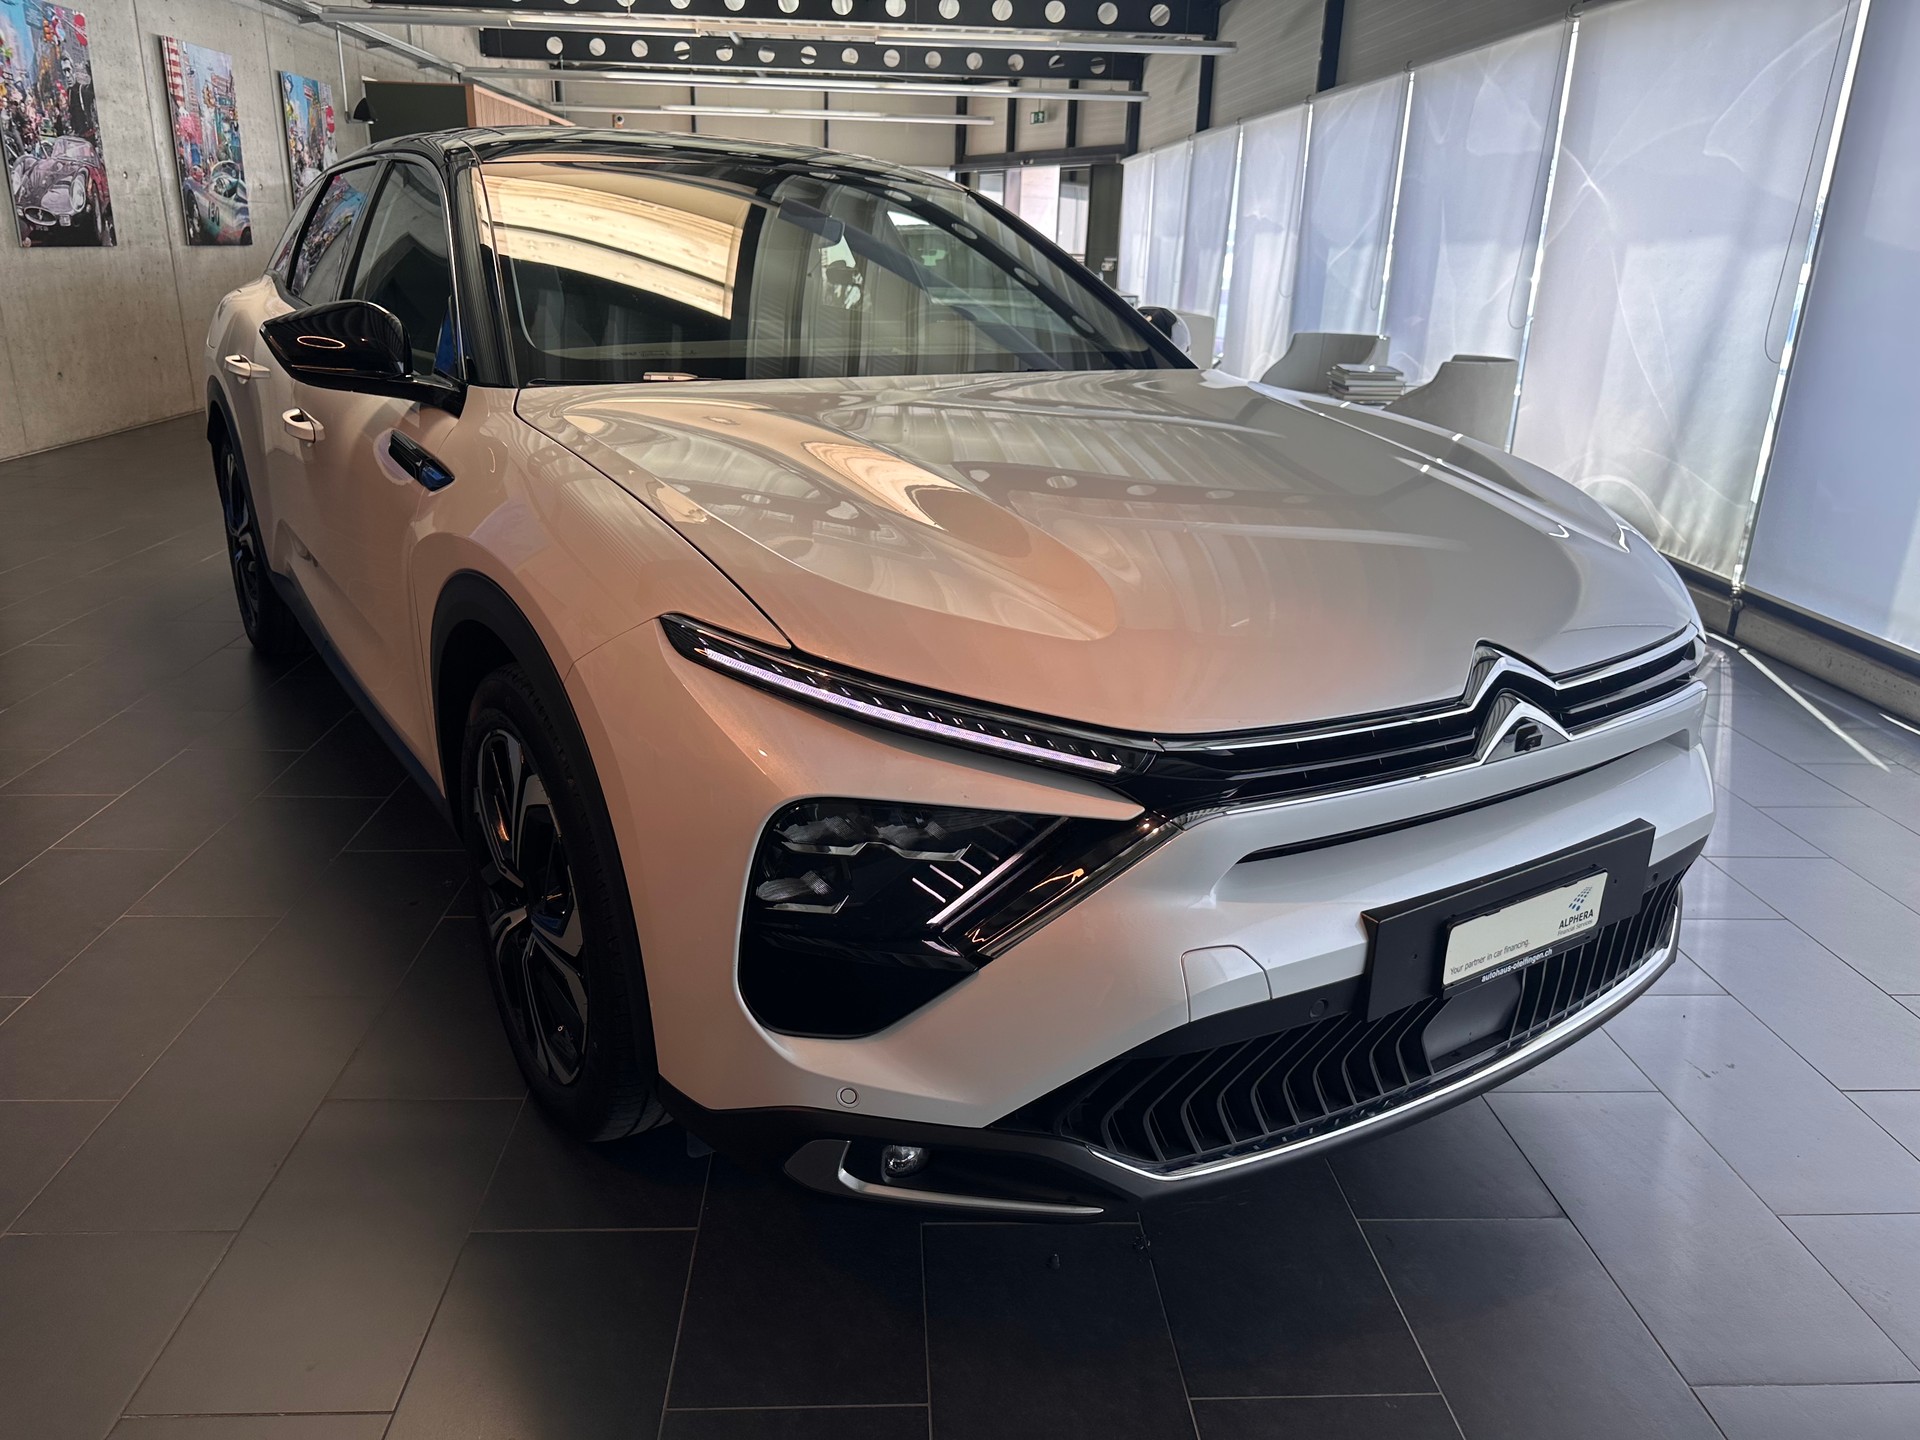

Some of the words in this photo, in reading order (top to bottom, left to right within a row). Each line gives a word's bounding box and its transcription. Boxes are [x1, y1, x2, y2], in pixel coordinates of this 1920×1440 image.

[1557, 926, 1575, 936] Financial
[1576, 919, 1593, 929] Services
[1559, 909, 1593, 929] ALPHERA
[1450, 965, 1463, 975] Your
[1464, 956, 1486, 971] partner
[1487, 953, 1493, 962] in
[1493, 950, 1502, 959] car
[1503, 939, 1530, 954] financing.
[1481, 948, 1553, 982] autohaus-otelfingen.ch
